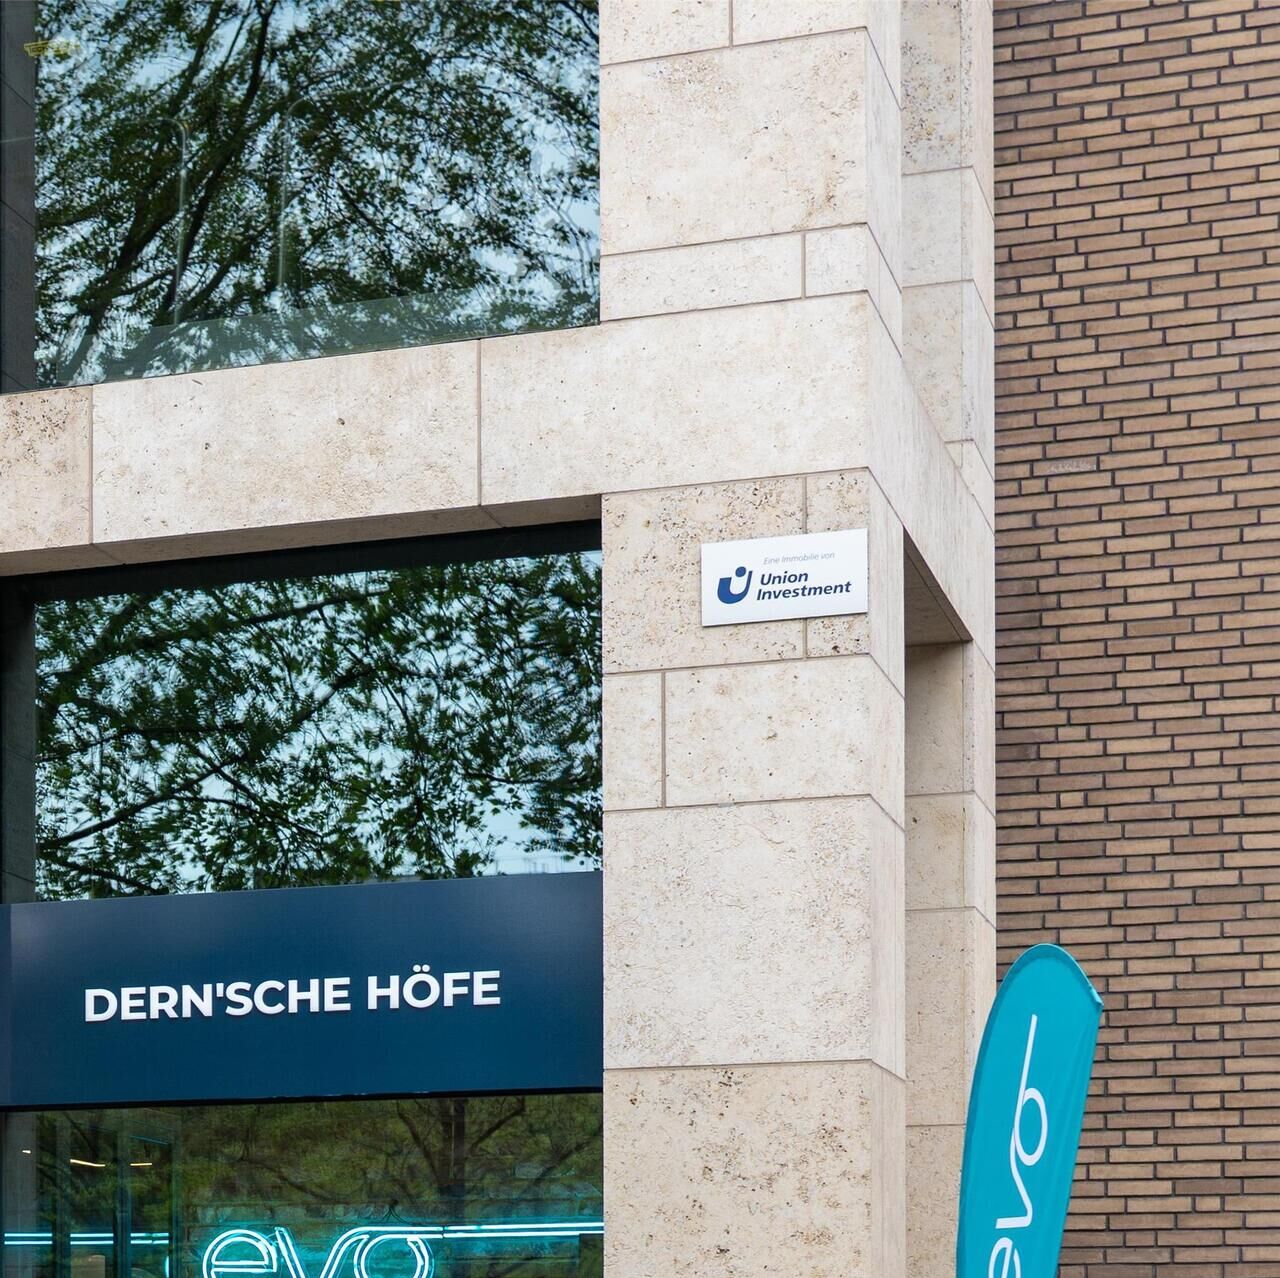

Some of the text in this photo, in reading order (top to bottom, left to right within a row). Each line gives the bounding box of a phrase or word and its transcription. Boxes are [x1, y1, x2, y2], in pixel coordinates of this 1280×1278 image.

[760, 570, 809, 586] Union
[756, 580, 852, 601] Investment
[84, 964, 501, 1023] DERN'SCHE HÖFE
